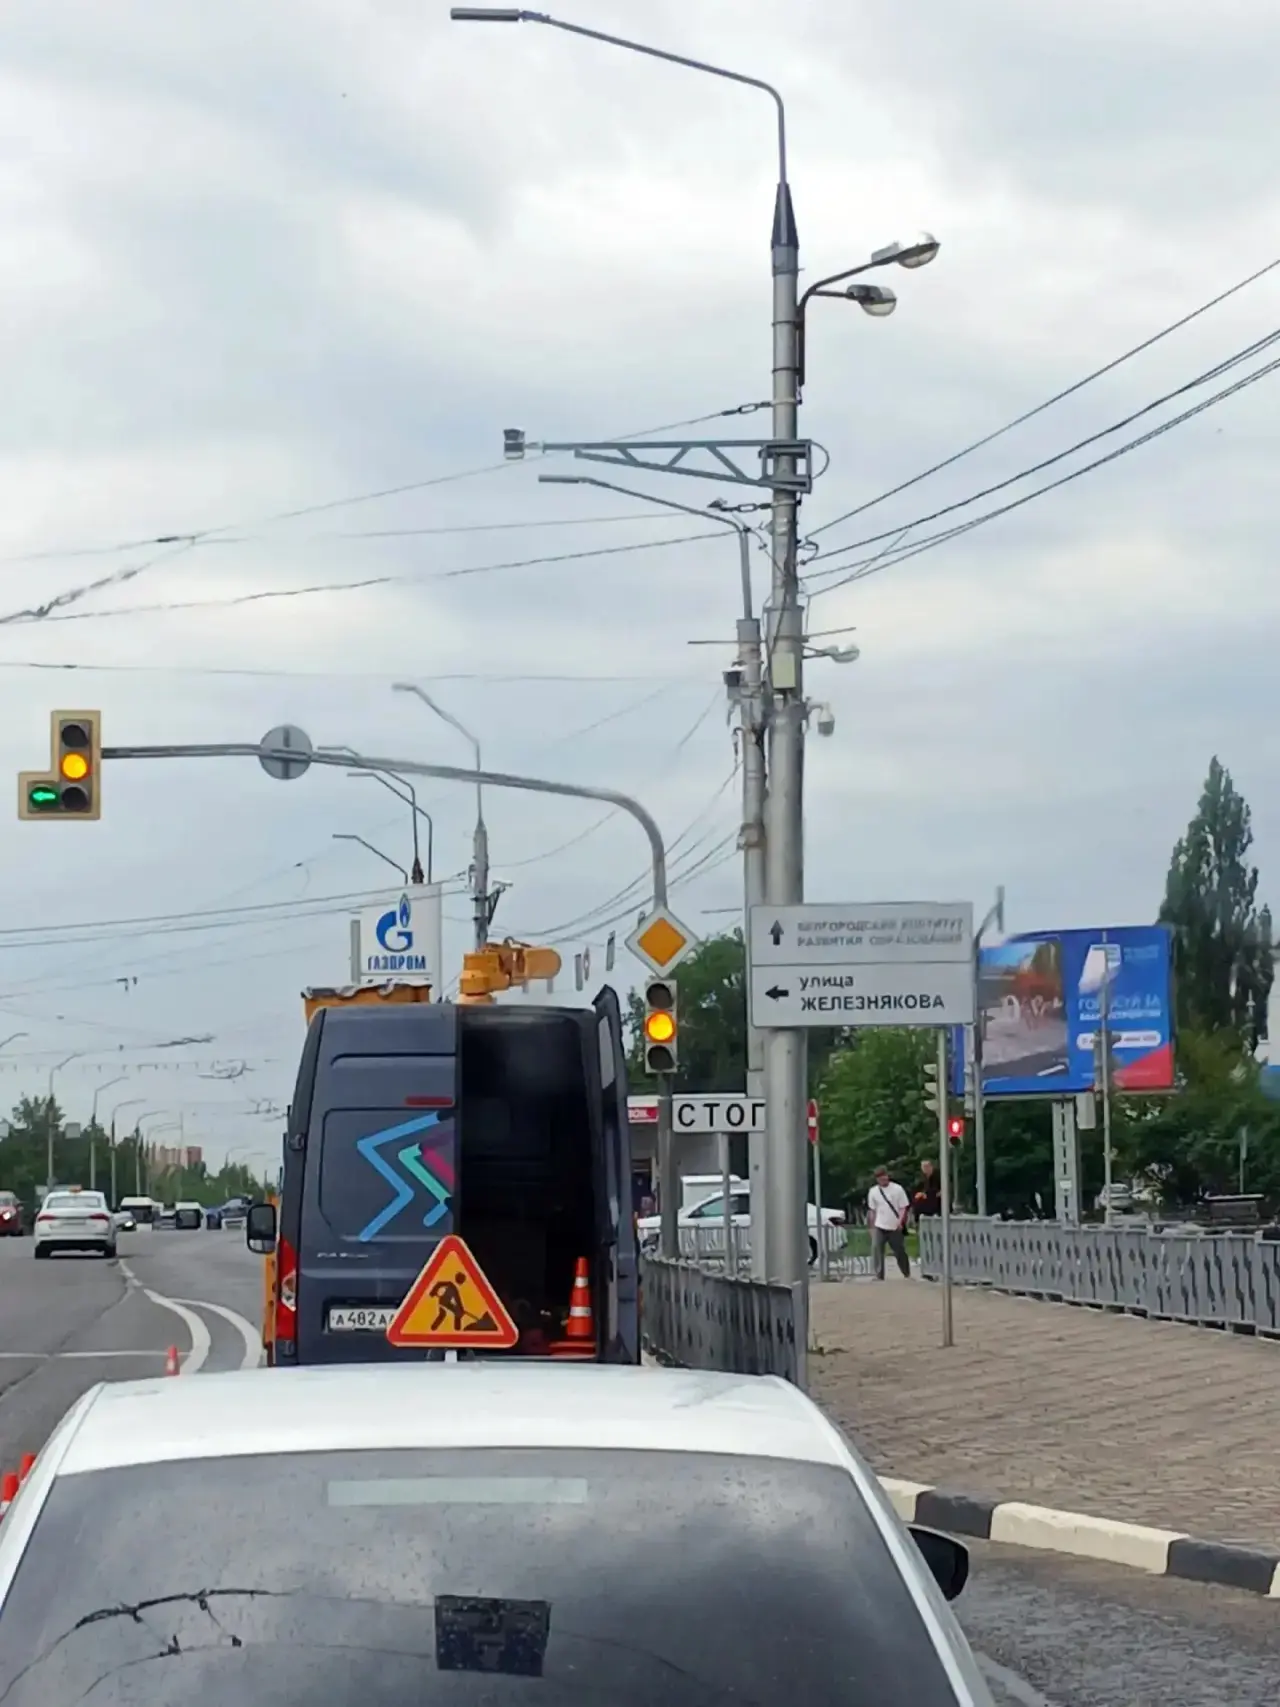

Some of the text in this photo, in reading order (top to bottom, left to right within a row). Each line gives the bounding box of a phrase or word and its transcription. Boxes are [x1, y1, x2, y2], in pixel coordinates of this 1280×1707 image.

[367, 955, 426, 971] ГАЗПРОМ
[800, 976, 854, 991] улица
[801, 995, 945, 1011] ЖЕЛЕЗНЯКОВА
